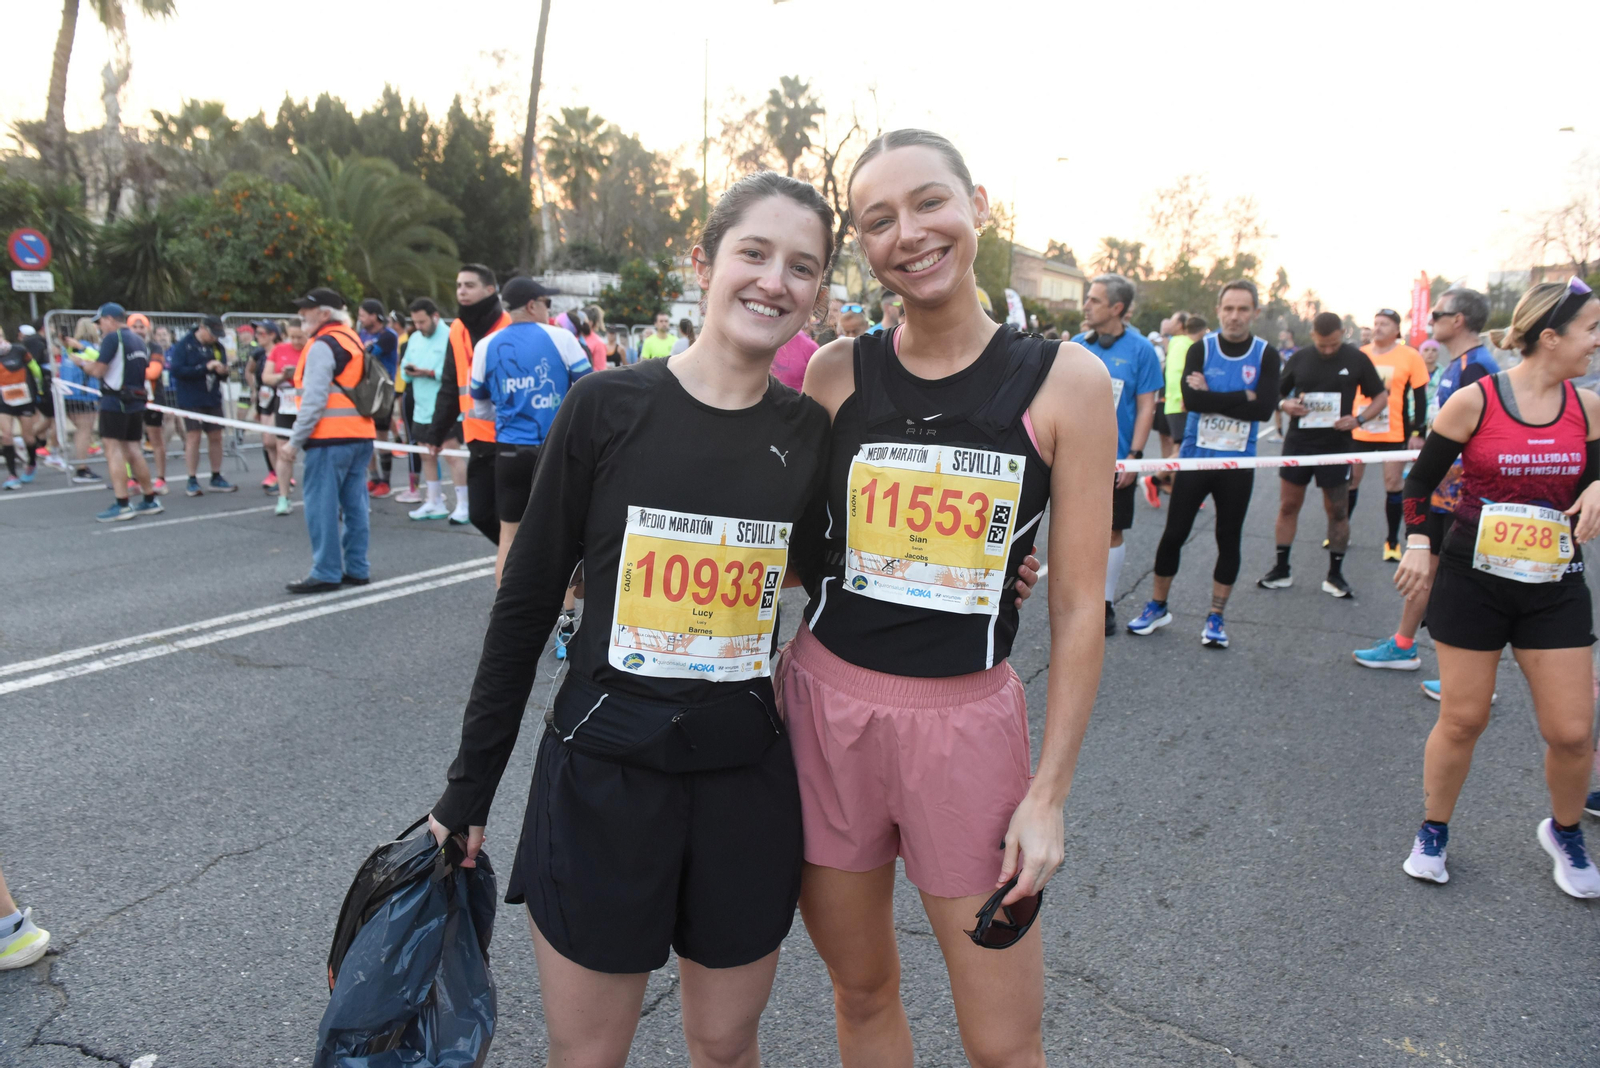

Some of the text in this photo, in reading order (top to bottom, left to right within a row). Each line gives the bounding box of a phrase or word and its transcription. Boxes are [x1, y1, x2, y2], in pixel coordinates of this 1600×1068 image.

[502, 376, 535, 395] iRun
[1204, 417, 1240, 433] 15071
[866, 446, 1001, 476] MEDIO MARATÓN SEVILLA
[1498, 452, 1581, 464] FROM LLEIDA TO
[1500, 465, 1581, 476] THE FINISH LINE
[860, 478, 990, 539] 11553
[639, 511, 776, 544] MEDIO MARATÓN SEVILLA
[909, 534, 928, 544] Sian
[1493, 521, 1553, 549] 9738
[904, 552, 928, 561] Jacobs
[623, 568, 632, 592] CAJÓN
[636, 551, 765, 608] 10933
[906, 587, 932, 599] HOKA
[692, 608, 714, 619] Lucy
[688, 626, 713, 635] Barnes
[688, 663, 715, 673] HOKA
